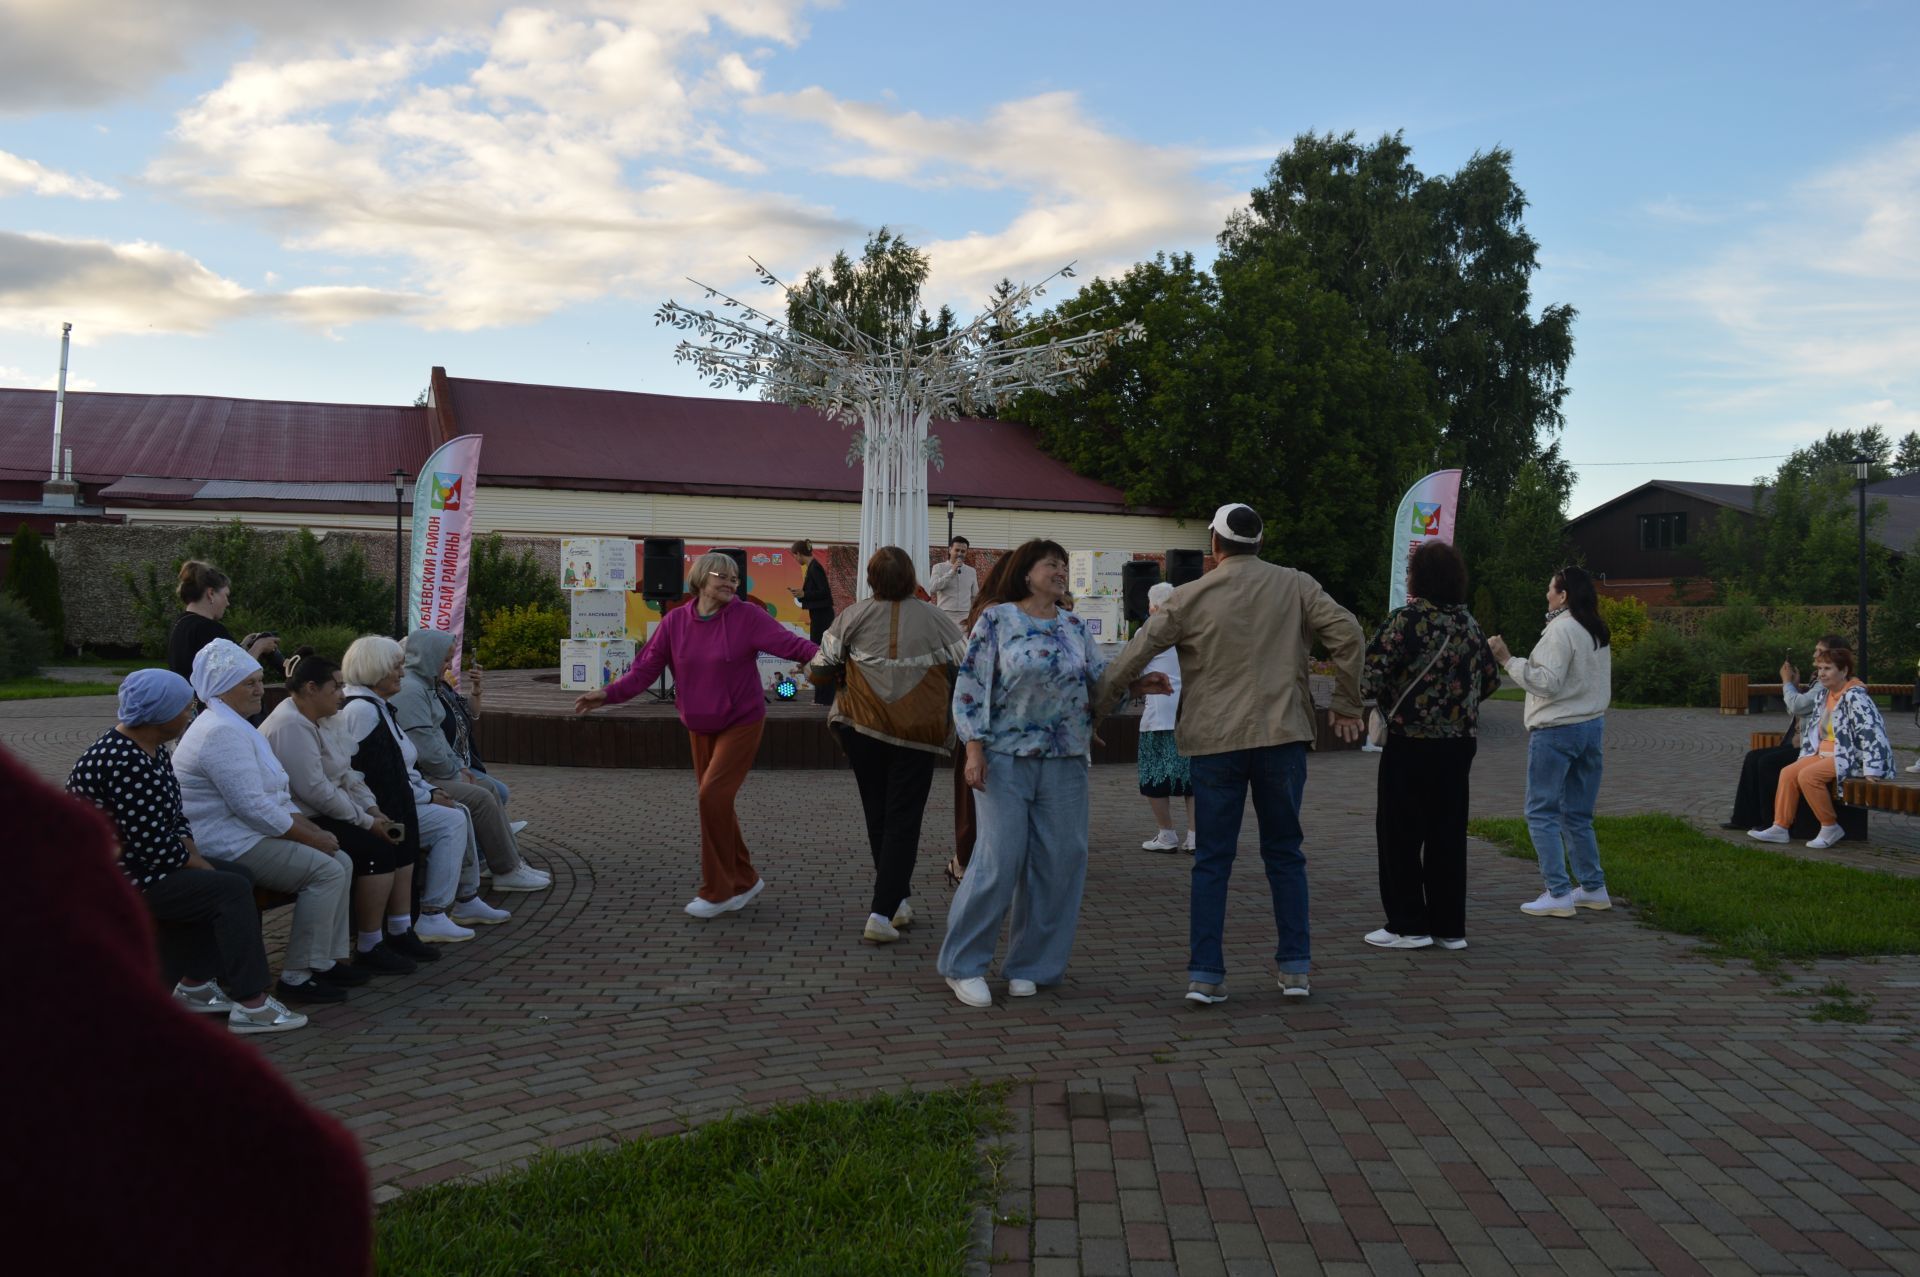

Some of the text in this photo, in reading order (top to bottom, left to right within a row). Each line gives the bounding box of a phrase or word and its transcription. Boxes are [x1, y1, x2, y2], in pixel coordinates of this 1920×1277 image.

[420, 516, 441, 630] УБАЕВСКИЙ РАЙОН
[436, 531, 460, 632] КСУБАЙ РАЙОНЫ
